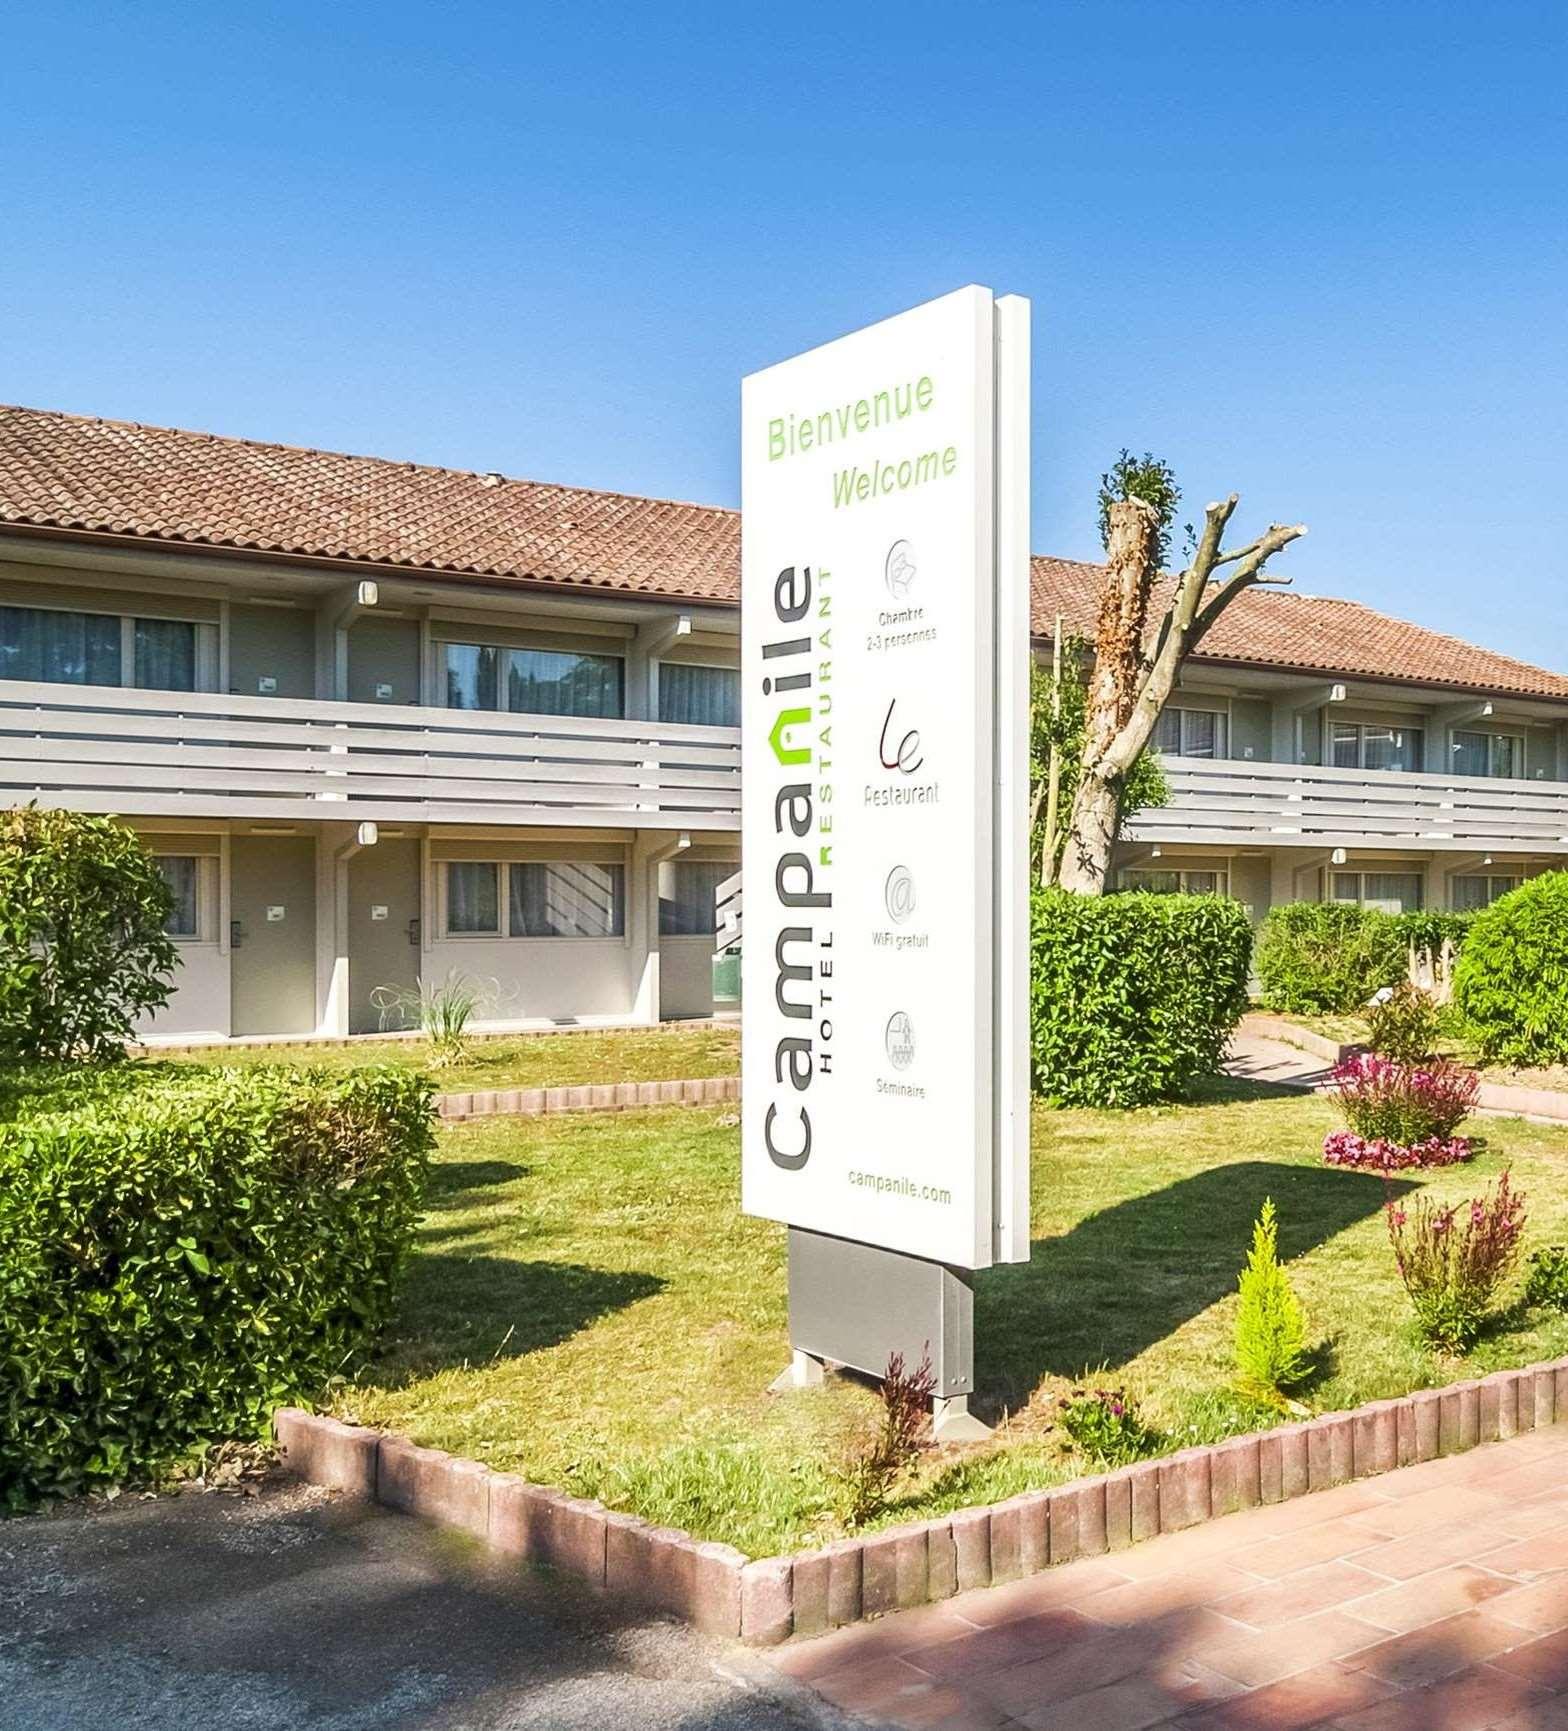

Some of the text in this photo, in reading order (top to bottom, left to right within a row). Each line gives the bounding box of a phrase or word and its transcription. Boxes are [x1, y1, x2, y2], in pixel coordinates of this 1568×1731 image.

[767, 374, 935, 463] Bienvenue
[832, 444, 958, 510] Welcome
[817, 566, 834, 1074] HOTEL RESTAURANT
[864, 781, 938, 807] Restaurant
[761, 565, 833, 1172] Campanile
[895, 933, 929, 951] gratuit
[847, 1170, 952, 1205] campanile.com
